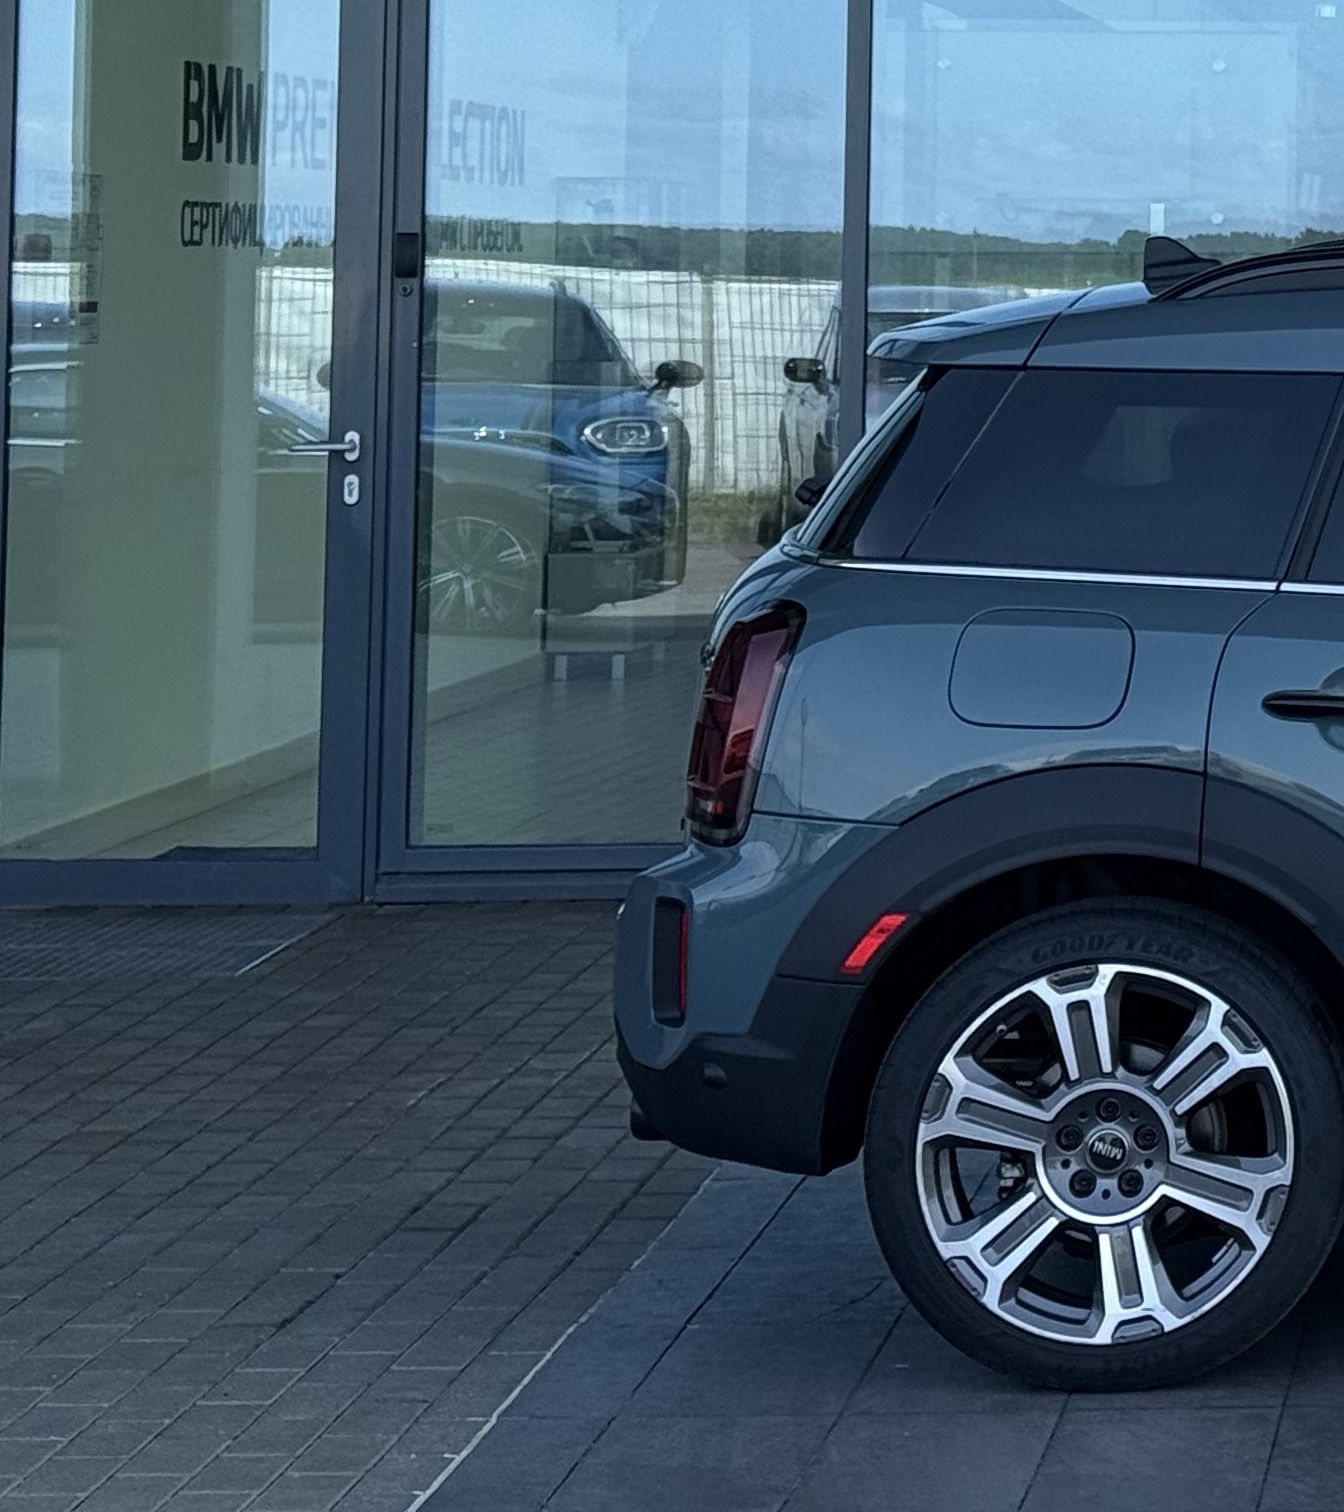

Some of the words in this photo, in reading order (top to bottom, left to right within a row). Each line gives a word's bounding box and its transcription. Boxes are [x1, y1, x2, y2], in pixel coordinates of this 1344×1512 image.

[182, 60, 265, 166] BMW
[271, 71, 336, 171] PRE
[1092, 1140, 1123, 1161] MINI
